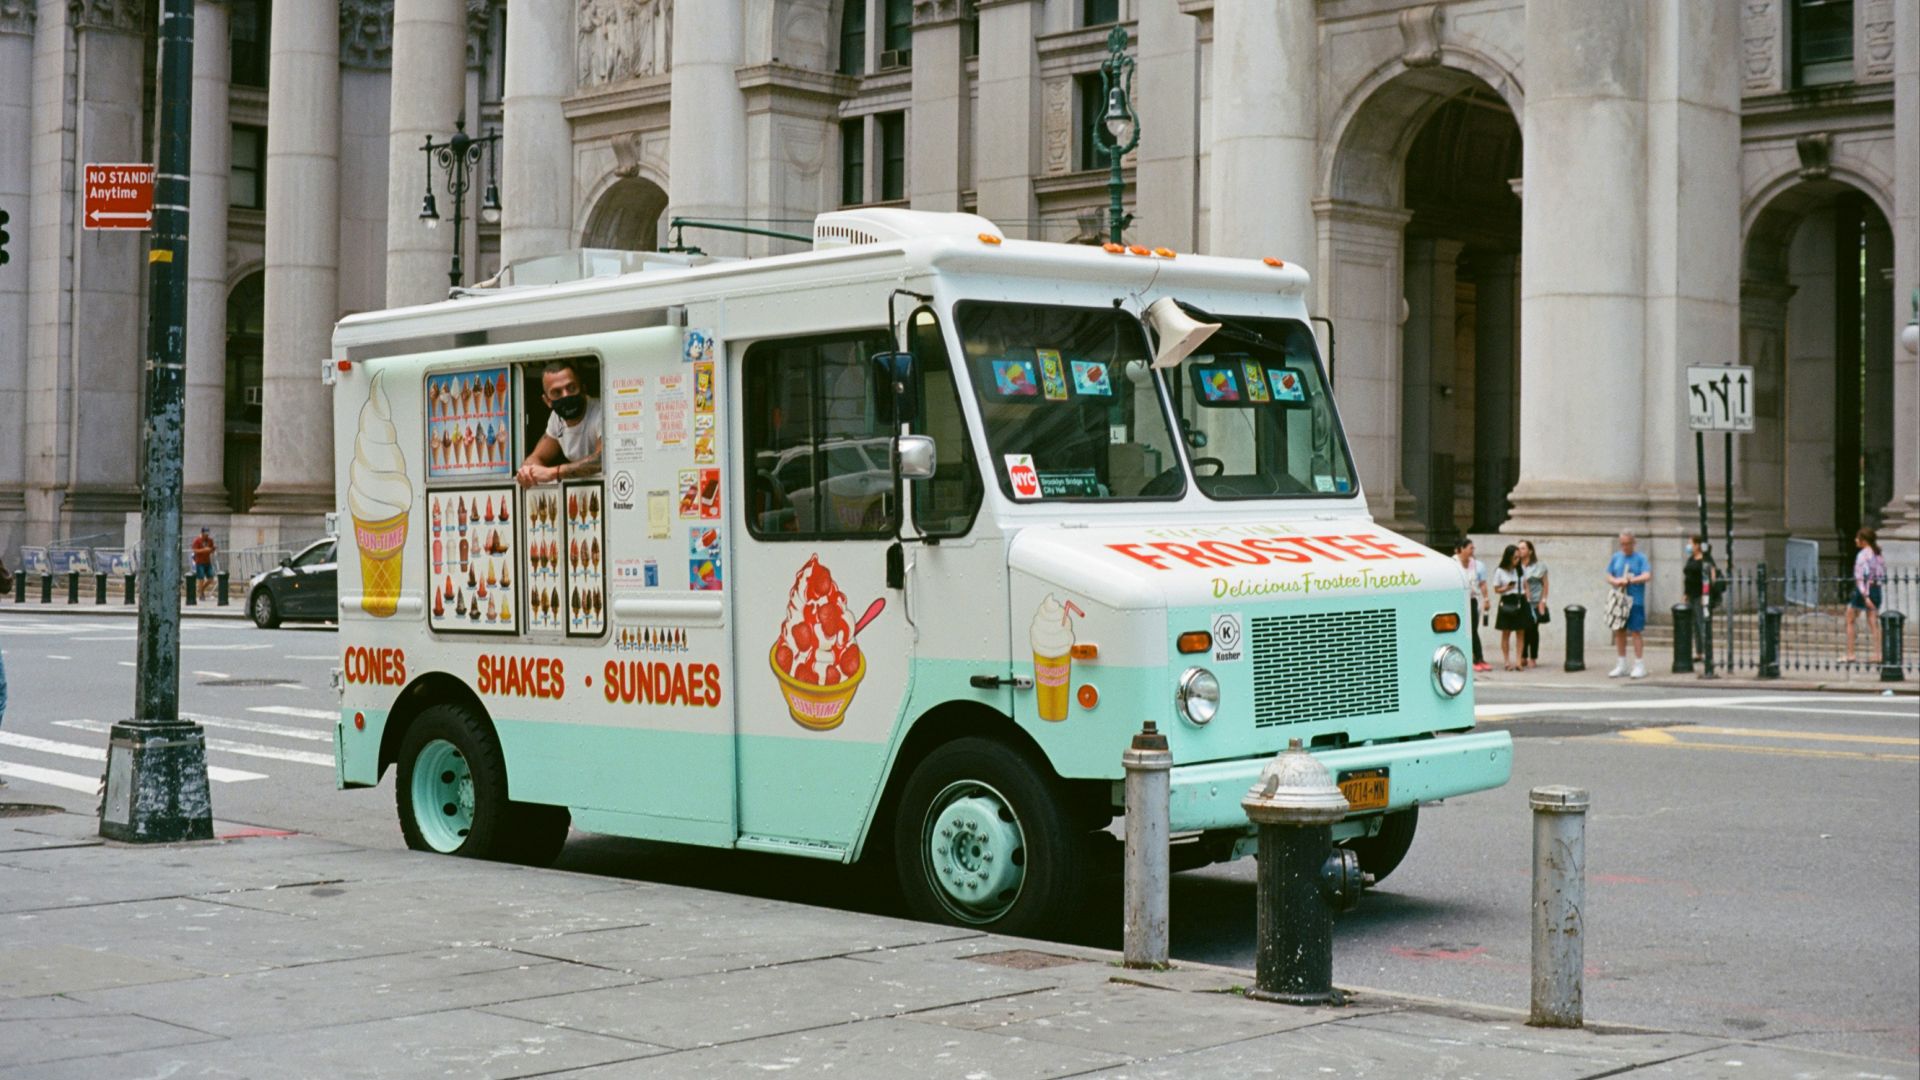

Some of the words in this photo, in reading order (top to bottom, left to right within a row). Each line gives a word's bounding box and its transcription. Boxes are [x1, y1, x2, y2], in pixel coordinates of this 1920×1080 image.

[89, 171, 106, 184] NO
[109, 171, 154, 184] STANDI
[89, 186, 138, 201] Anytime
[1012, 471, 1036, 487] NYC
[1040, 478, 1065, 486] Brooklyn
[1065, 477, 1083, 486] Bridge
[619, 481, 627, 492] K
[1043, 486, 1055, 495] City
[1055, 486, 1067, 494] Hall
[613, 501, 634, 510] Kosher
[357, 525, 404, 551] FUN-TIME
[1103, 533, 1427, 570] FROSTEE
[1211, 577, 1300, 599] Delicious
[1301, 572, 1361, 594] Frostee
[1358, 568, 1421, 589] Treats
[1222, 626, 1231, 639] K
[1216, 651, 1241, 661] Kosher
[344, 645, 407, 687] CONES
[477, 654, 565, 700] SHAKES
[604, 660, 722, 708] SUNDAES
[789, 693, 846, 719] FUN-TIME
